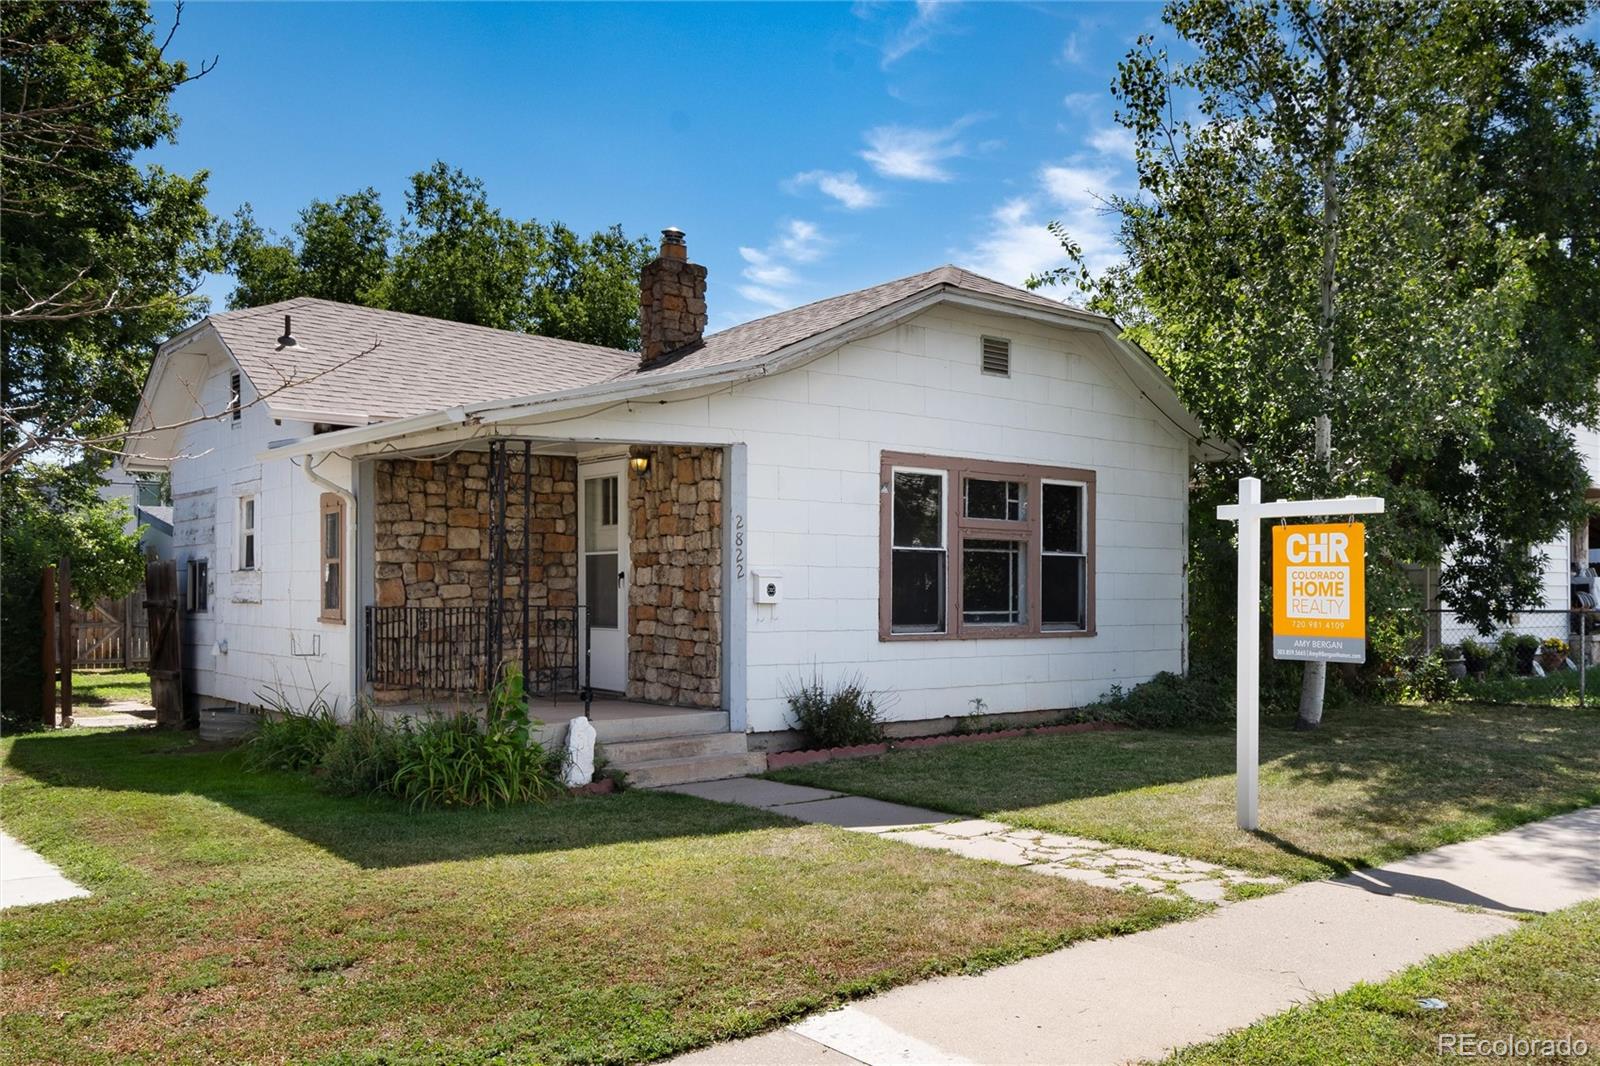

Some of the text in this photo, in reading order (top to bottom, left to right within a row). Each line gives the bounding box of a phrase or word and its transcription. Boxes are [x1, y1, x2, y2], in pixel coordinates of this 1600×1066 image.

[735, 514, 744, 579] 2822
[1287, 533, 1349, 563] CHR
[1292, 571, 1344, 580] COLORADO
[1293, 582, 1344, 597] HOME
[1292, 599, 1344, 614] REALTY
[1294, 640, 1343, 649] AMY BERGAN
